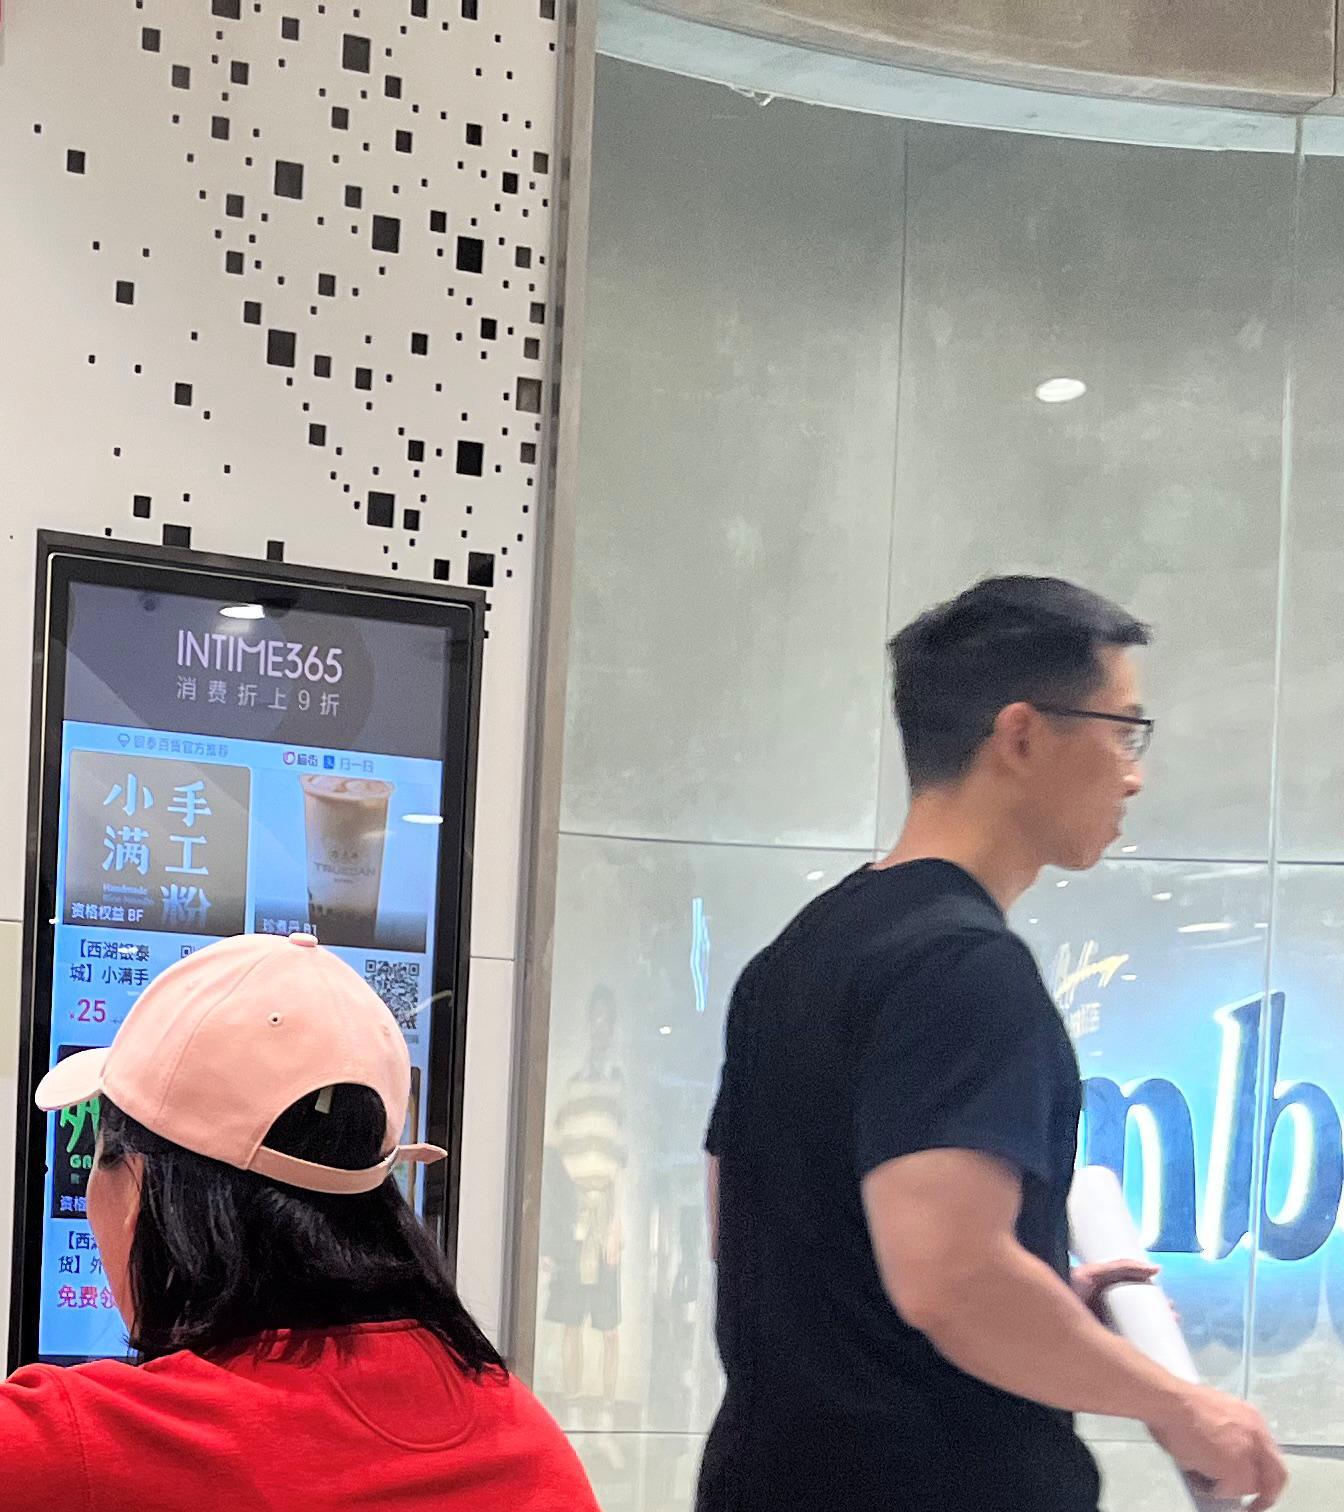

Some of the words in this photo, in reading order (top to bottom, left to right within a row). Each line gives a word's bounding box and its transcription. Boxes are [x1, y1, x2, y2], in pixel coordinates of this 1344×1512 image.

[176, 629, 344, 684] INTIME365
[175, 676, 340, 717] 消费折上9折
[101, 772, 154, 876] 小满
